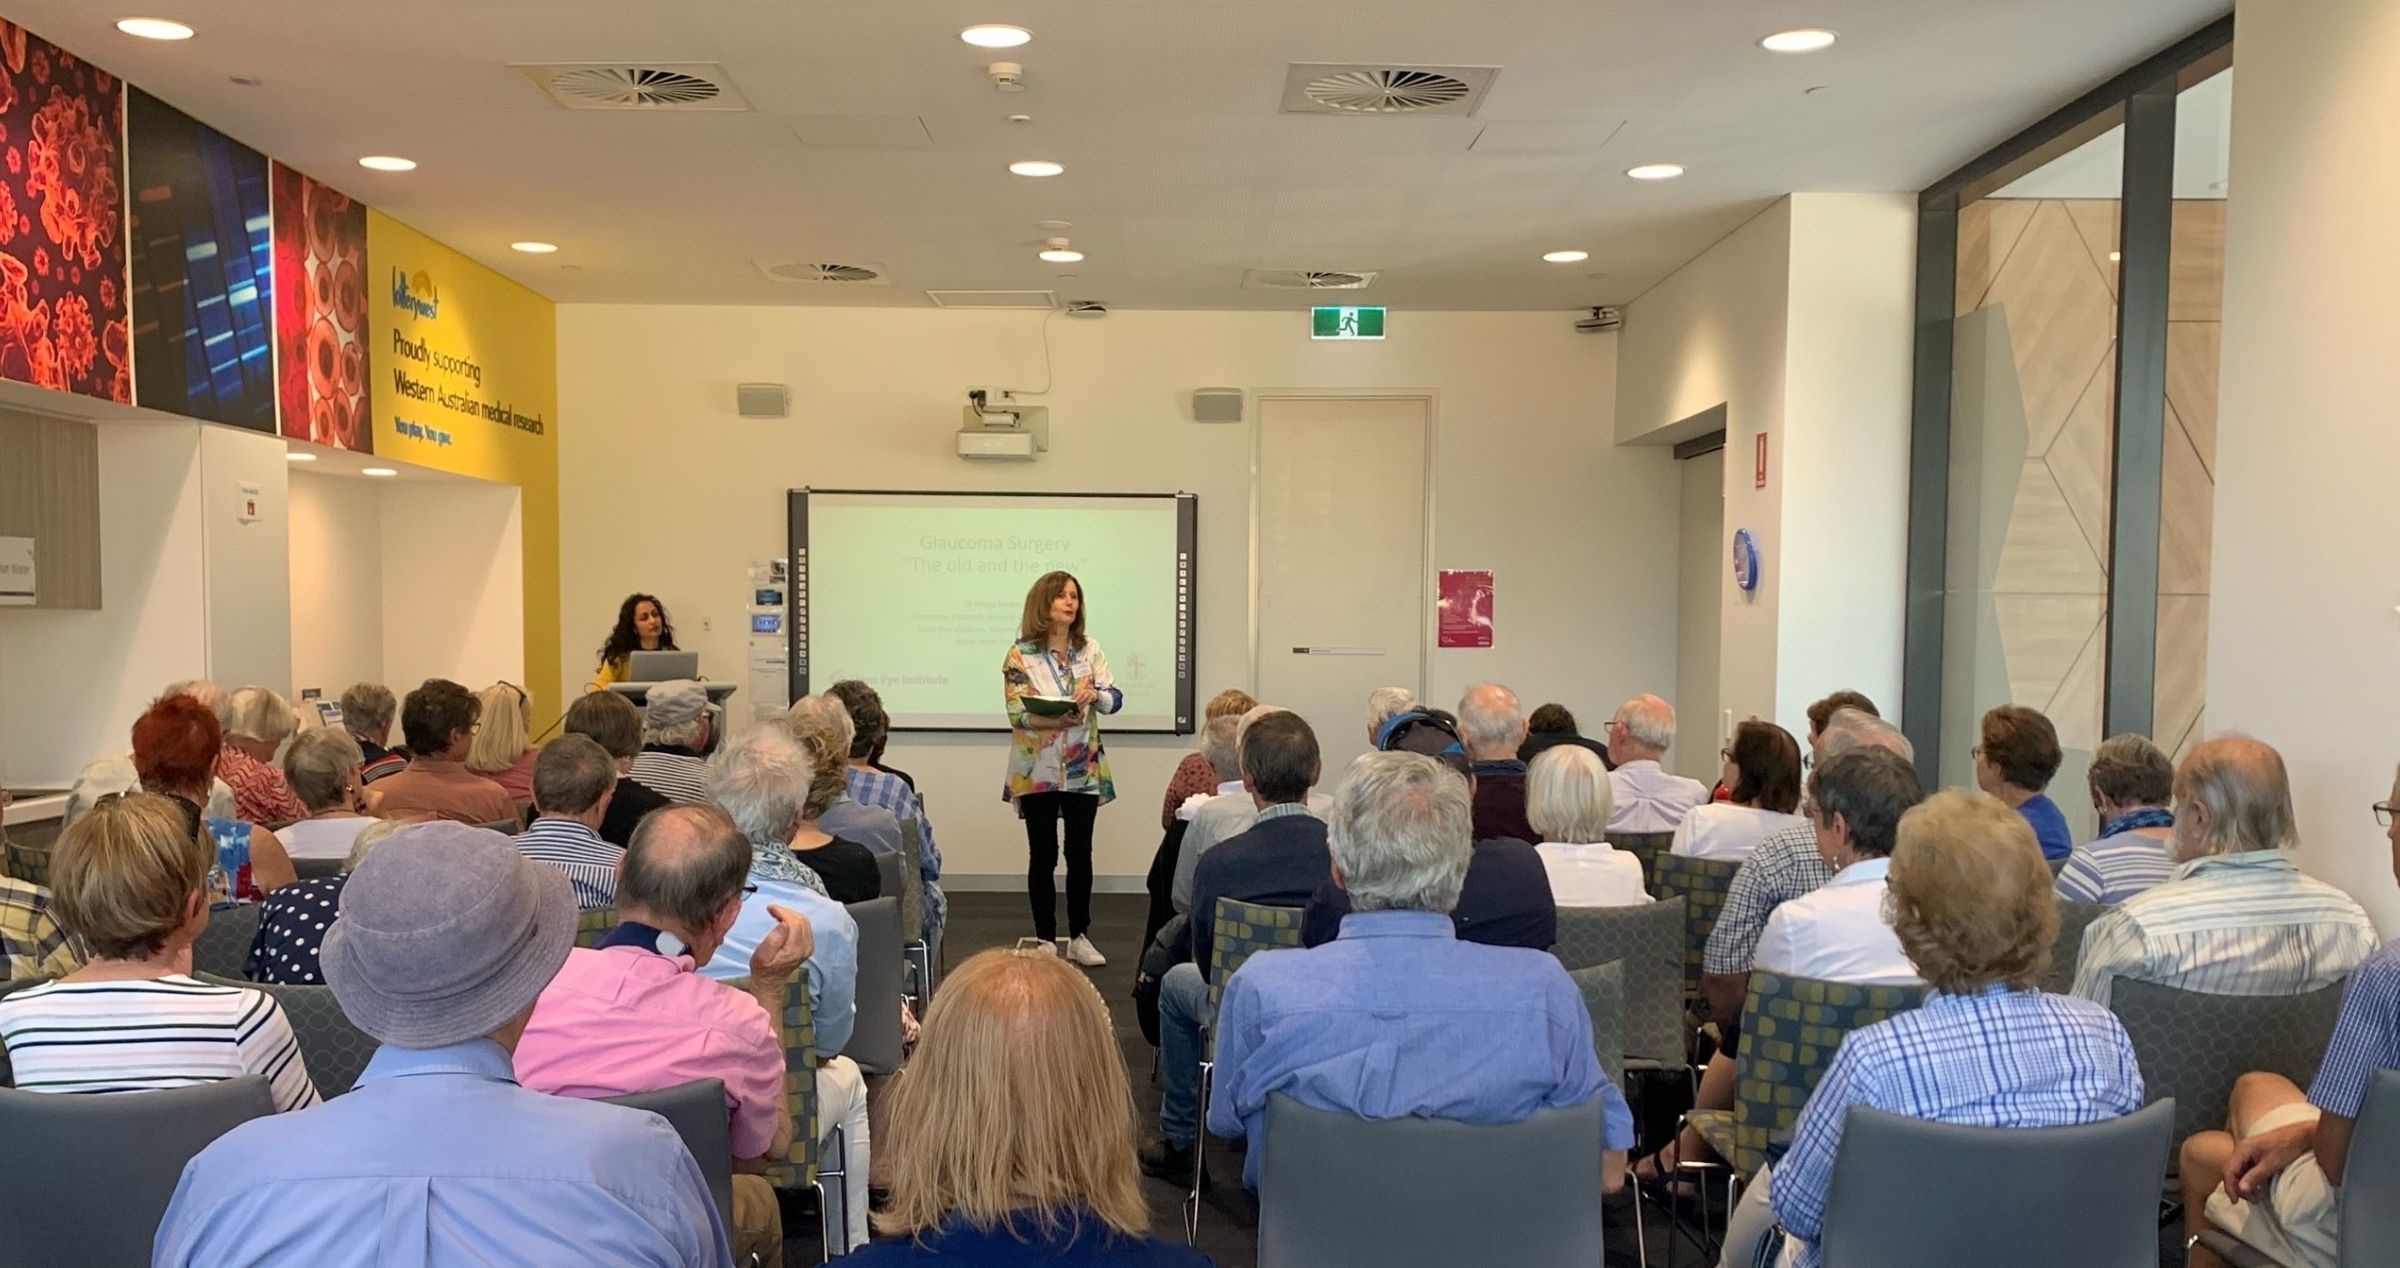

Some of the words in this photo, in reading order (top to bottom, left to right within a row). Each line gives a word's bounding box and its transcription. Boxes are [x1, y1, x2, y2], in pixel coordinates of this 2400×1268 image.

[393, 328, 431, 371] Proudly
[433, 350, 480, 388] supporting
[393, 368, 435, 403] Western
[437, 384, 479, 417] Australian
[481, 400, 512, 425] medical
[513, 413, 544, 435] research
[394, 415, 409, 434] You
[920, 535, 1002, 550] Glaucoma
[1008, 536, 1070, 553] Surgery
[946, 557, 972, 572] old
[977, 558, 1007, 573] and
[1013, 558, 1040, 572] the
